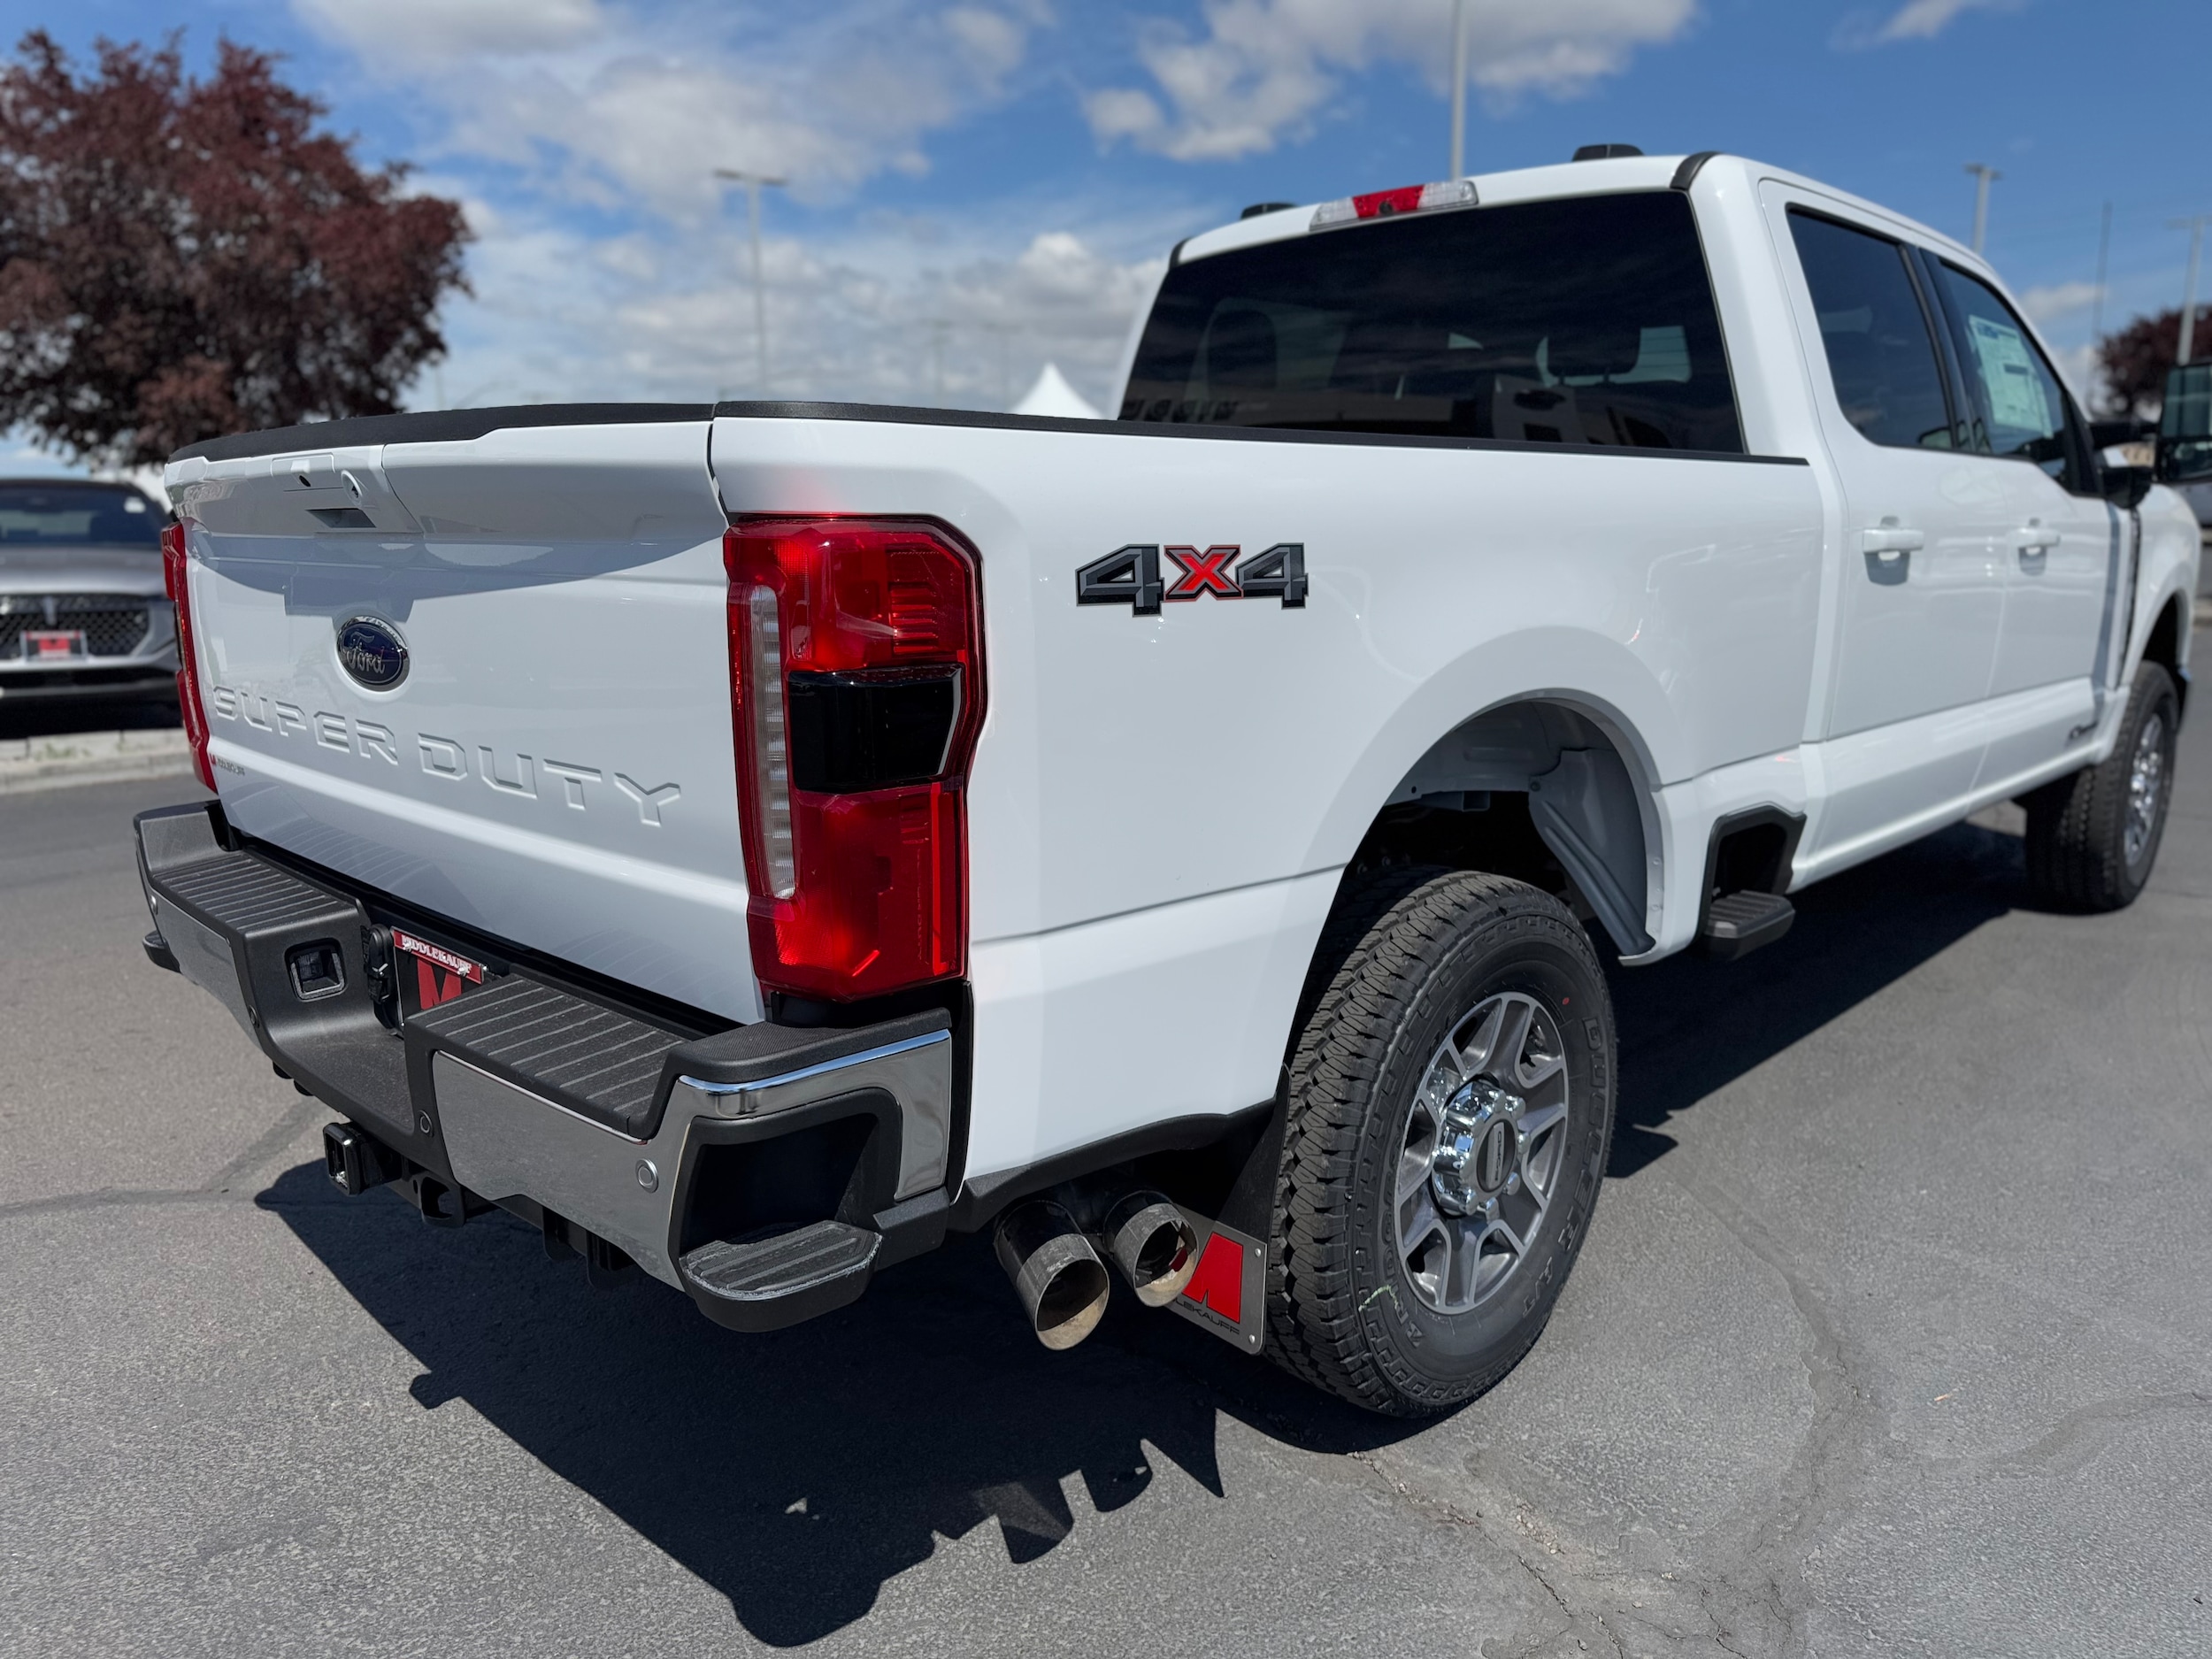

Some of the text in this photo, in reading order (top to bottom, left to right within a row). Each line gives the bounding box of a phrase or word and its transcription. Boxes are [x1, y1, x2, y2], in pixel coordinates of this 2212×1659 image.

[343, 630, 386, 674] Ford
[212, 686, 681, 827] SUPER DUTY
[1171, 1297, 1240, 1335] LEKAUFF
